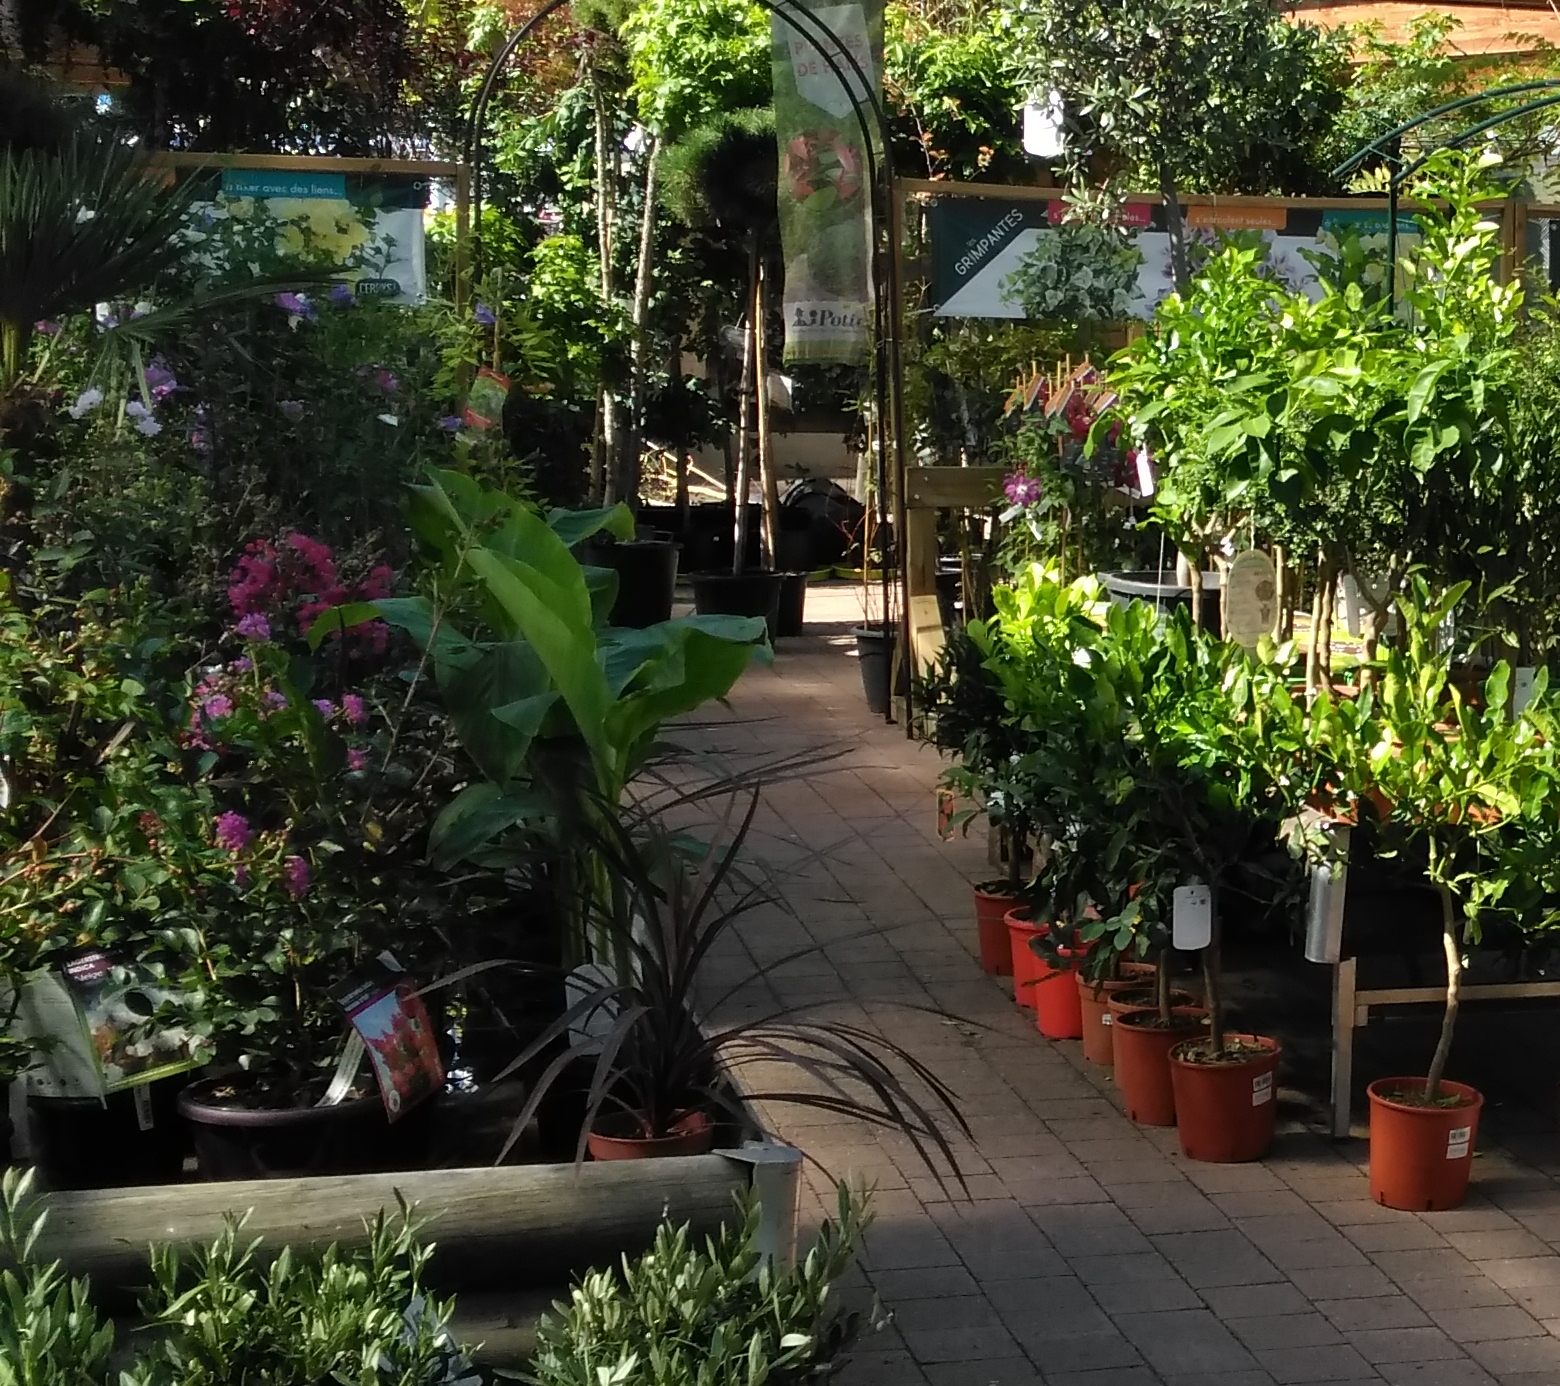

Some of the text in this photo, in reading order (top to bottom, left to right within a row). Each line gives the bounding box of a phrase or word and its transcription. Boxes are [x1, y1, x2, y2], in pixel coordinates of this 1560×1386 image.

[262, 185, 288, 194] avec
[290, 183, 308, 194] des
[954, 208, 1024, 276] GRIMPANTES
